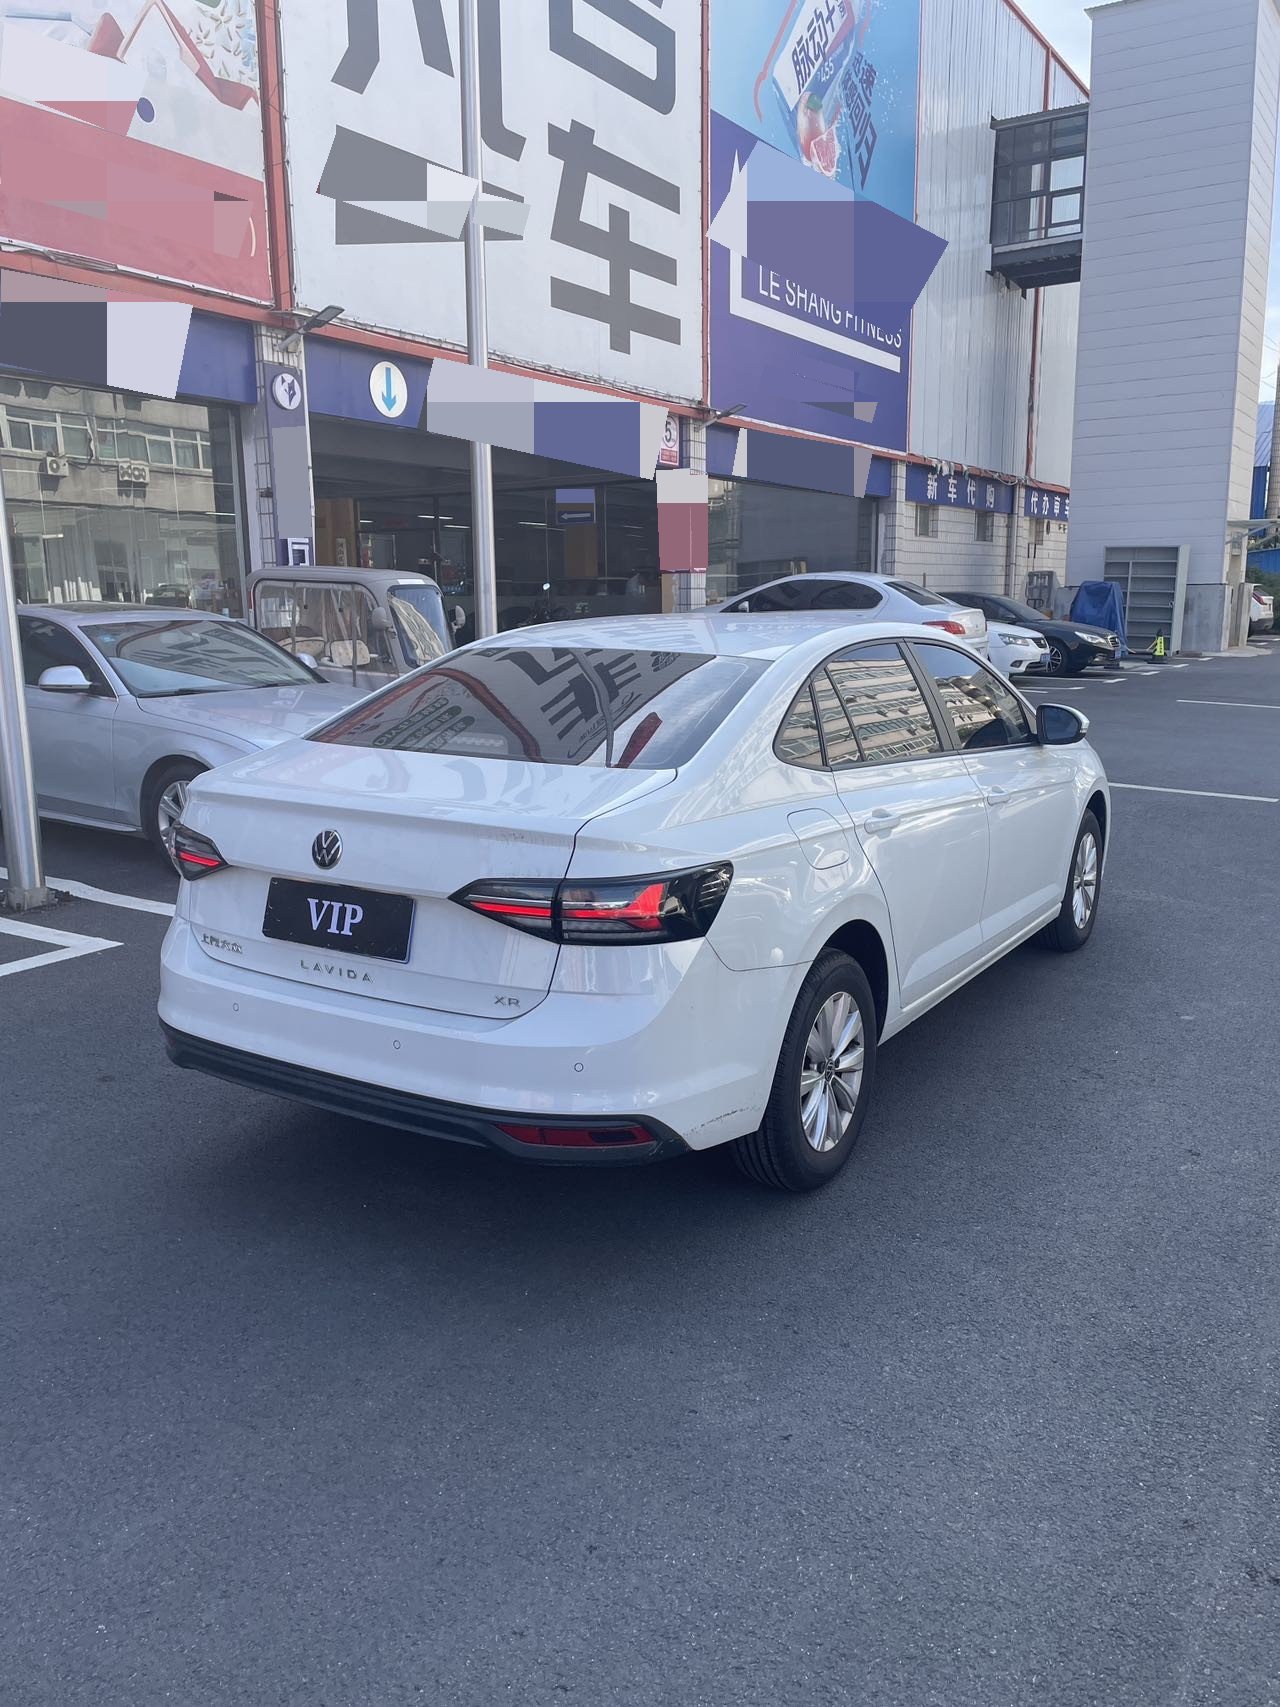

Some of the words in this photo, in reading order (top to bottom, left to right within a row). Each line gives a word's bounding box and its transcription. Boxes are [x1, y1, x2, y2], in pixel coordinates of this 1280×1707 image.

[759, 264, 780, 301] LE
[786, 279, 841, 325] SHANG
[927, 473, 995, 509] 新车代购
[306, 897, 364, 936] VIP
[300, 959, 375, 984] LAVIDA
[494, 994, 520, 1008] XR
